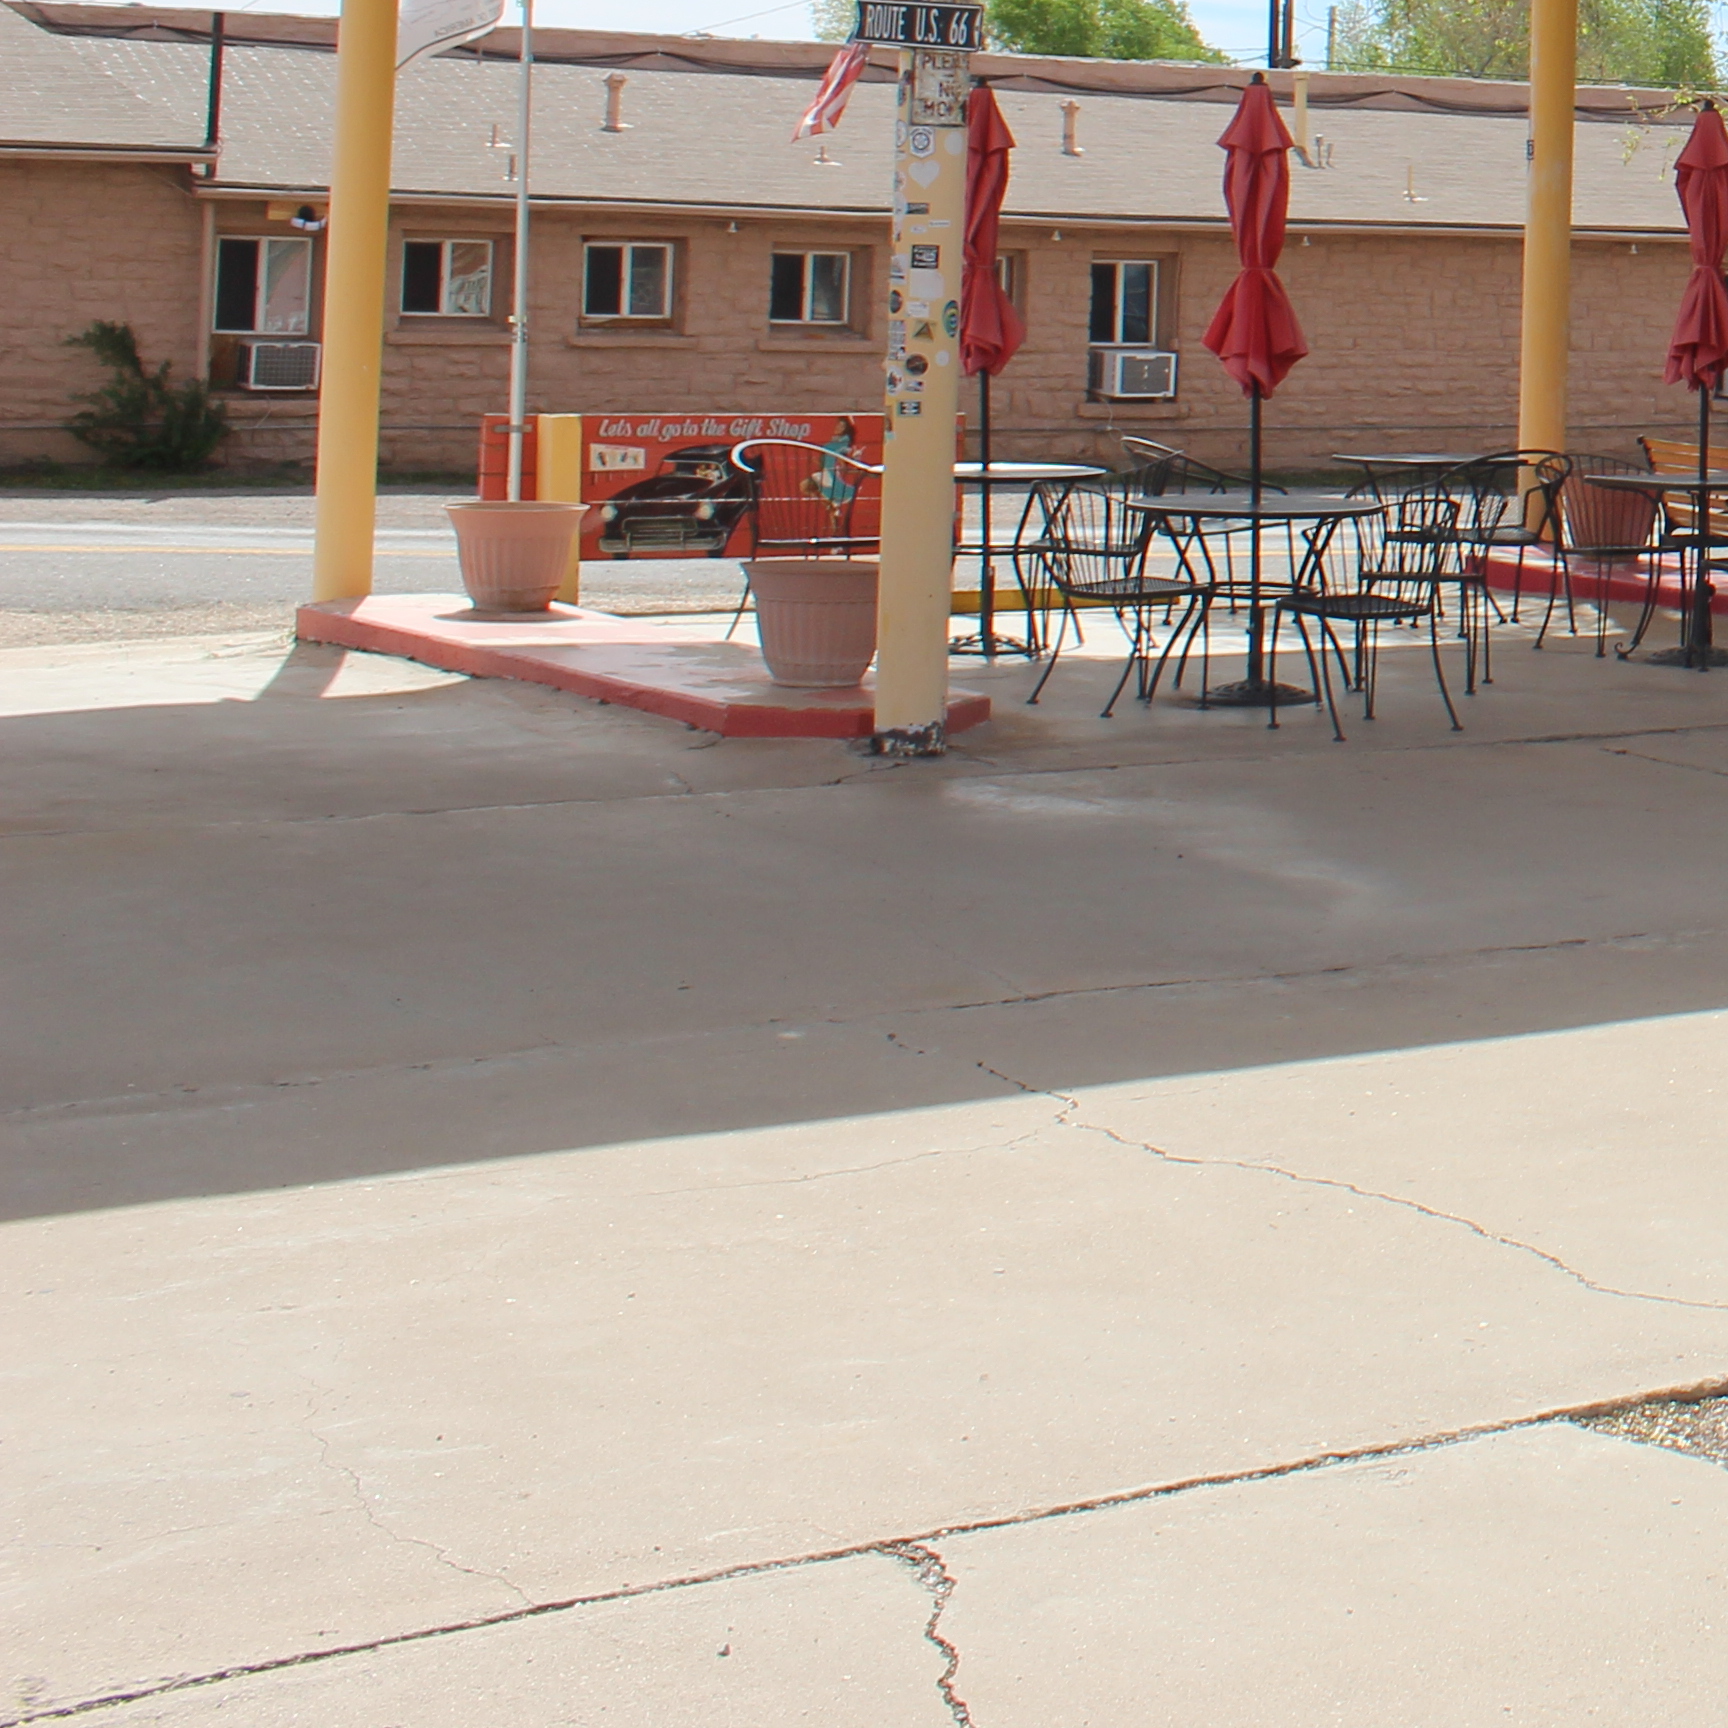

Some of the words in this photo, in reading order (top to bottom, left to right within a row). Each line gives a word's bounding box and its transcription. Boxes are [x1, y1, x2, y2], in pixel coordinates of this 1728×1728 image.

[864, 4, 908, 40] ROUTE
[914, 8, 941, 43] U.S.
[950, 11, 969, 45] 66
[599, 419, 632, 438] Lets
[636, 419, 659, 438] all
[700, 419, 726, 438] the
[729, 419, 763, 441] Gift
[766, 418, 811, 441] Shop
